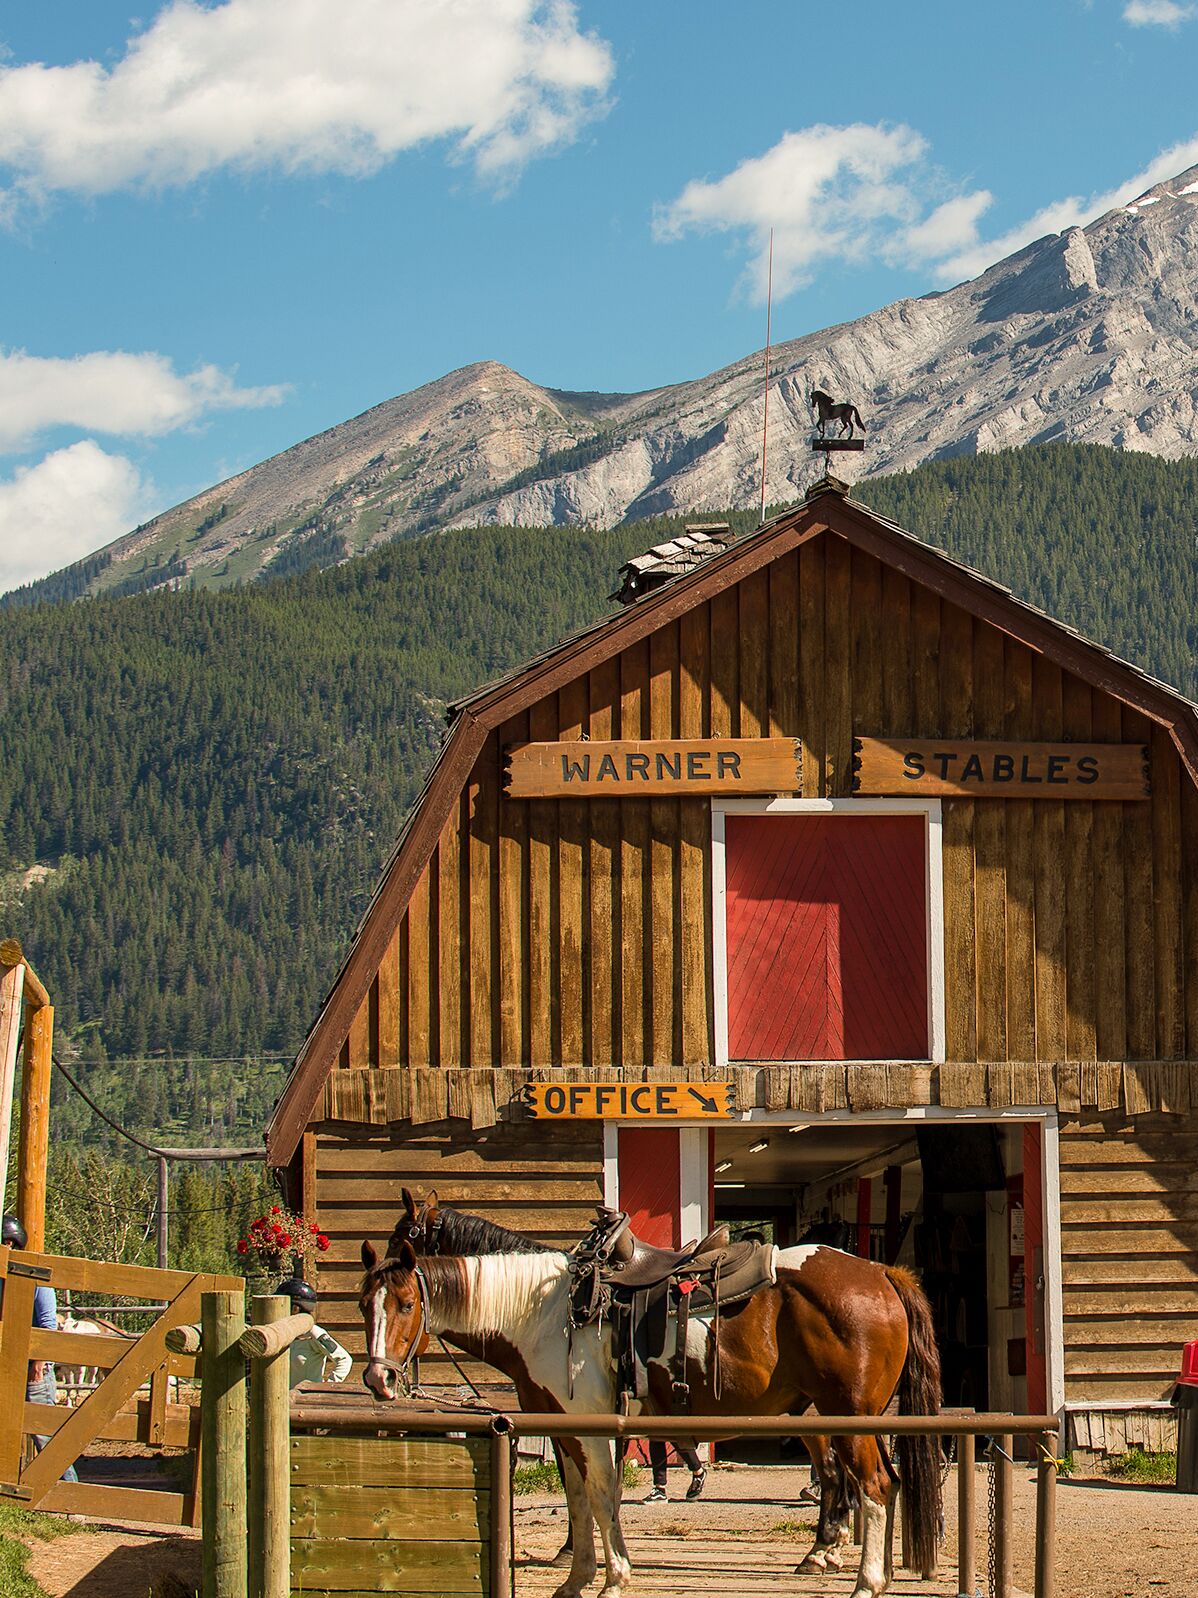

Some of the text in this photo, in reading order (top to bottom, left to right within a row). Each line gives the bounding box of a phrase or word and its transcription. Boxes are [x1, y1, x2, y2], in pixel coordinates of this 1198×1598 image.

[561, 752, 741, 782] WARNER
[902, 752, 1100, 784] STABLES
[544, 1086, 677, 1114] OFFICE
